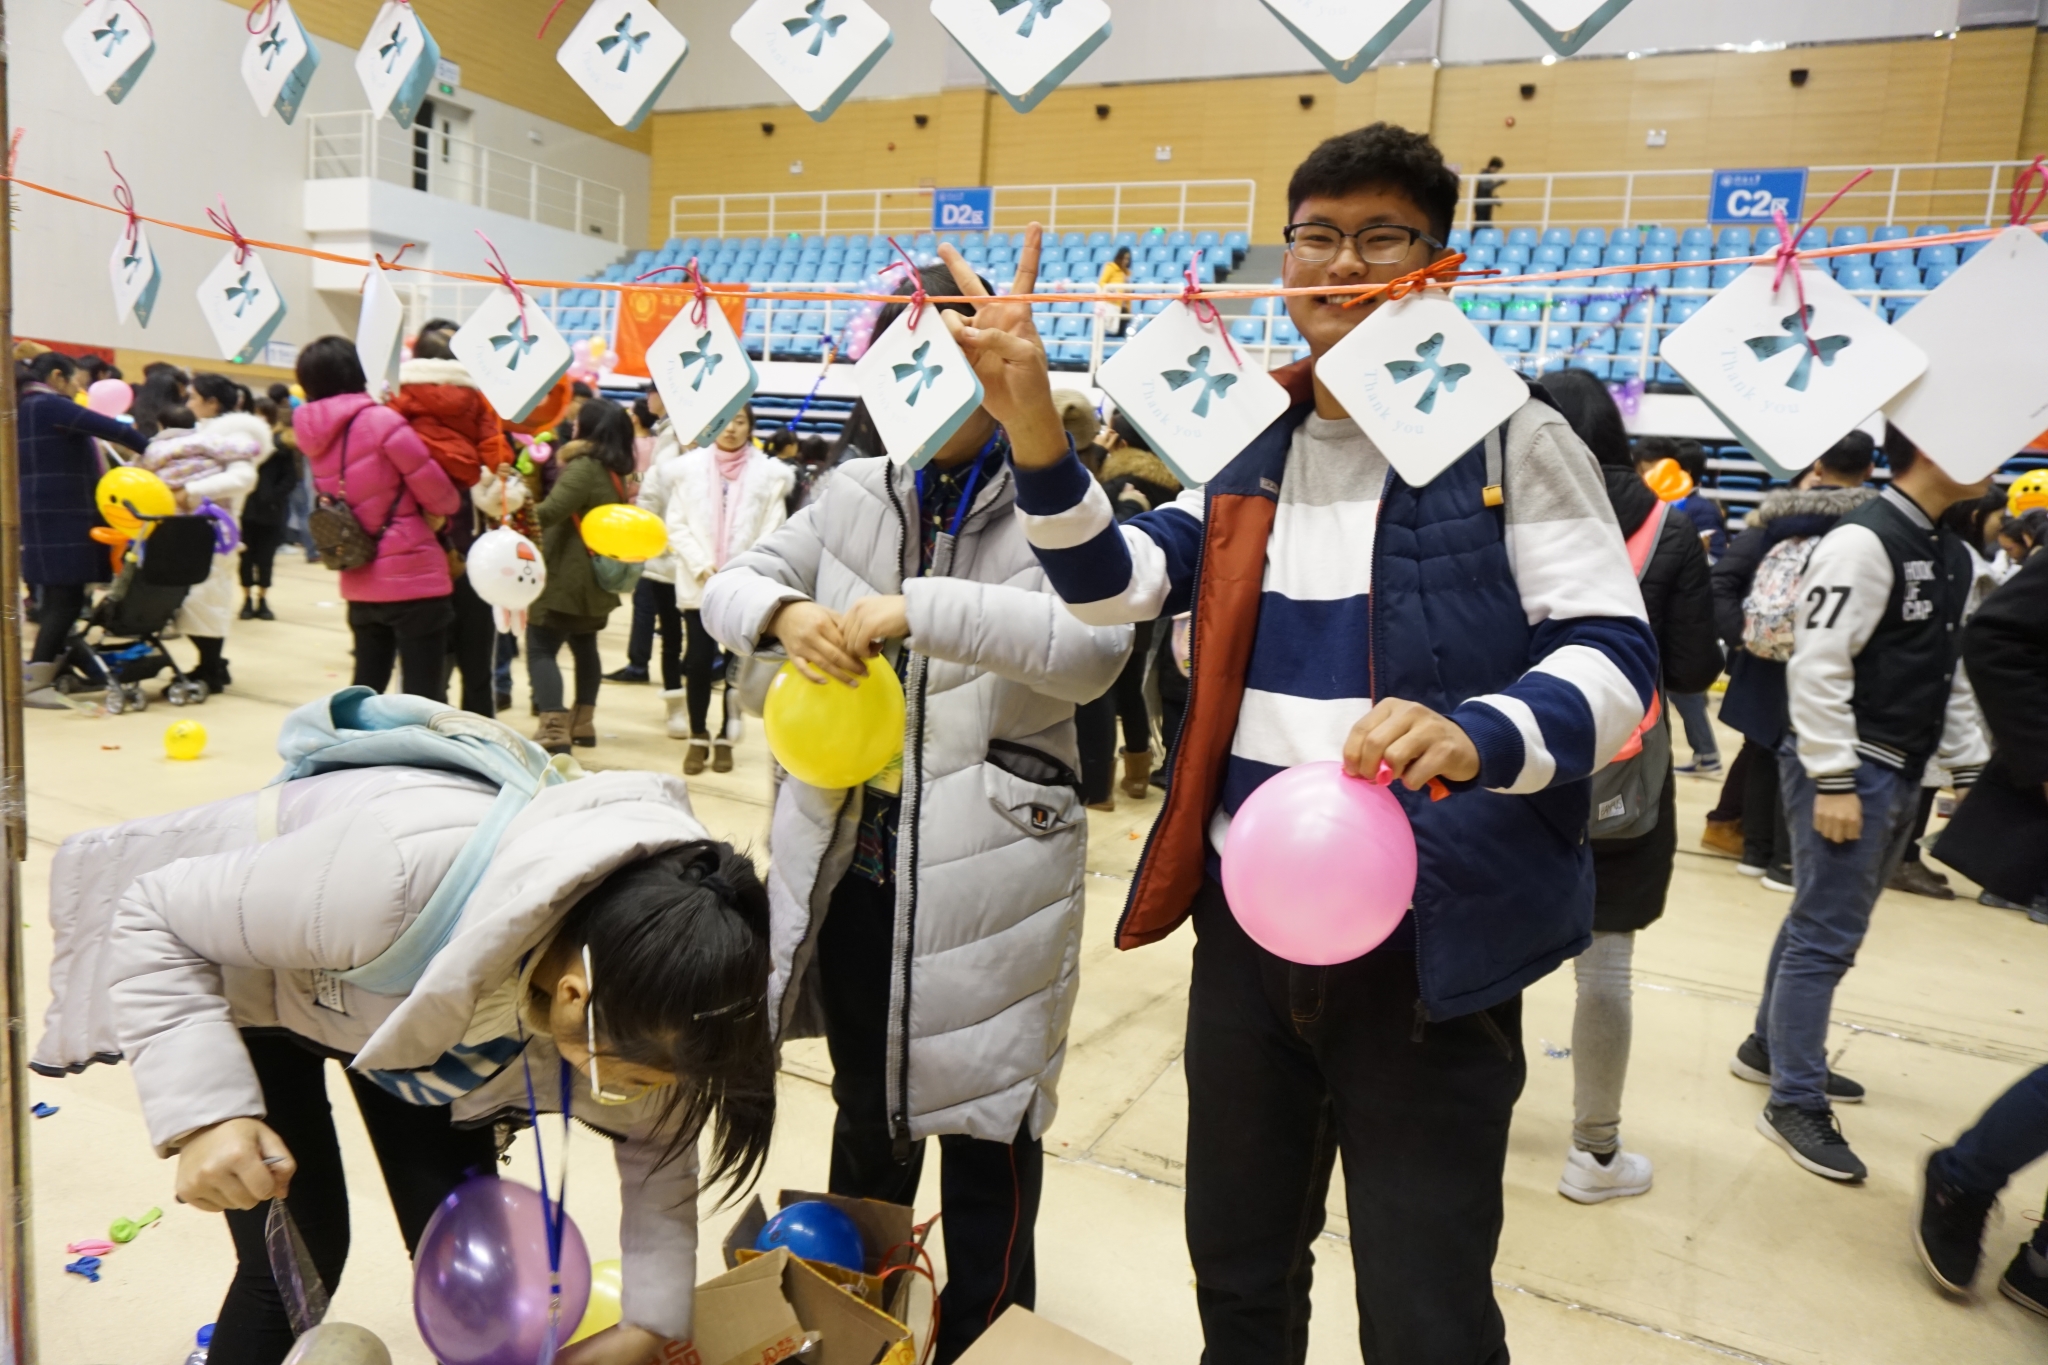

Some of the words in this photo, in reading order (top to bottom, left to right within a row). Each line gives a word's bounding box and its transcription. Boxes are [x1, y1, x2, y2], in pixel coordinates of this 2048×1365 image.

[942, 203, 984, 225] D2区
[1363, 368, 1392, 421] Thank
[1392, 419, 1425, 435] you
[1720, 345, 1757, 402] Thank
[1759, 399, 1801, 415] you
[1141, 378, 1171, 427] Thank
[1172, 424, 1203, 439] you
[1805, 585, 1852, 629] 27
[1902, 599, 1934, 622] CAP
